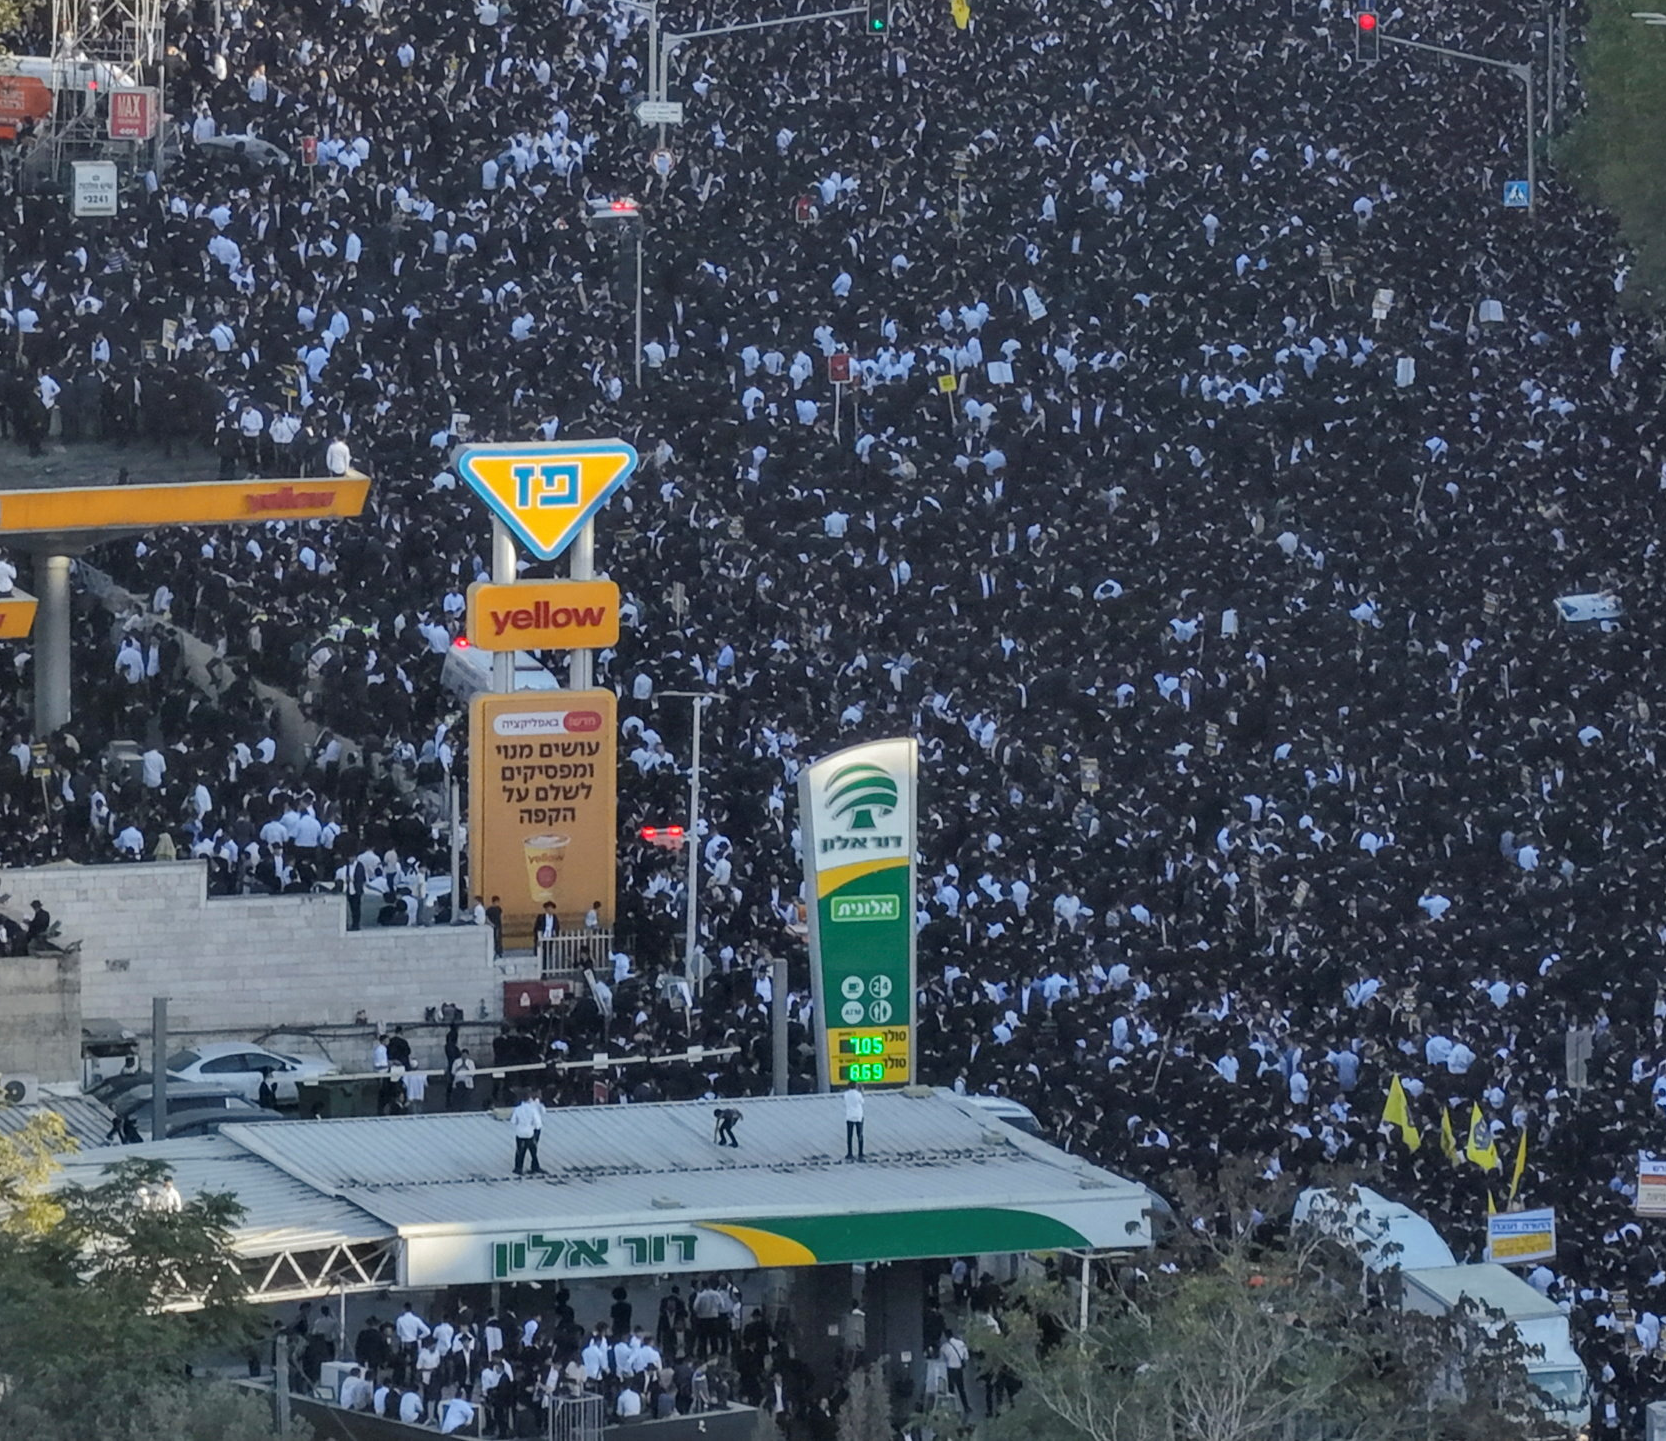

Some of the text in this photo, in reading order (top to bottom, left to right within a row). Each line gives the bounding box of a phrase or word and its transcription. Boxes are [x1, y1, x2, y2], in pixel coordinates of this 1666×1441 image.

[511, 462, 582, 510] פז
[246, 486, 336, 514] yellow
[490, 600, 606, 637] yellow
[501, 716, 560, 731] באפליקציה
[495, 740, 601, 760] עושים מנוי
[501, 762, 595, 785] ומפסיקים
[502, 782, 593, 804] לשלם על
[519, 806, 577, 827] הקפה
[820, 834, 903, 854] דור אלון
[837, 900, 894, 917] אלונית
[882, 1029, 907, 1043] סולר
[882, 1055, 907, 1069] סולר
[492, 1232, 699, 1280] דור אלון
